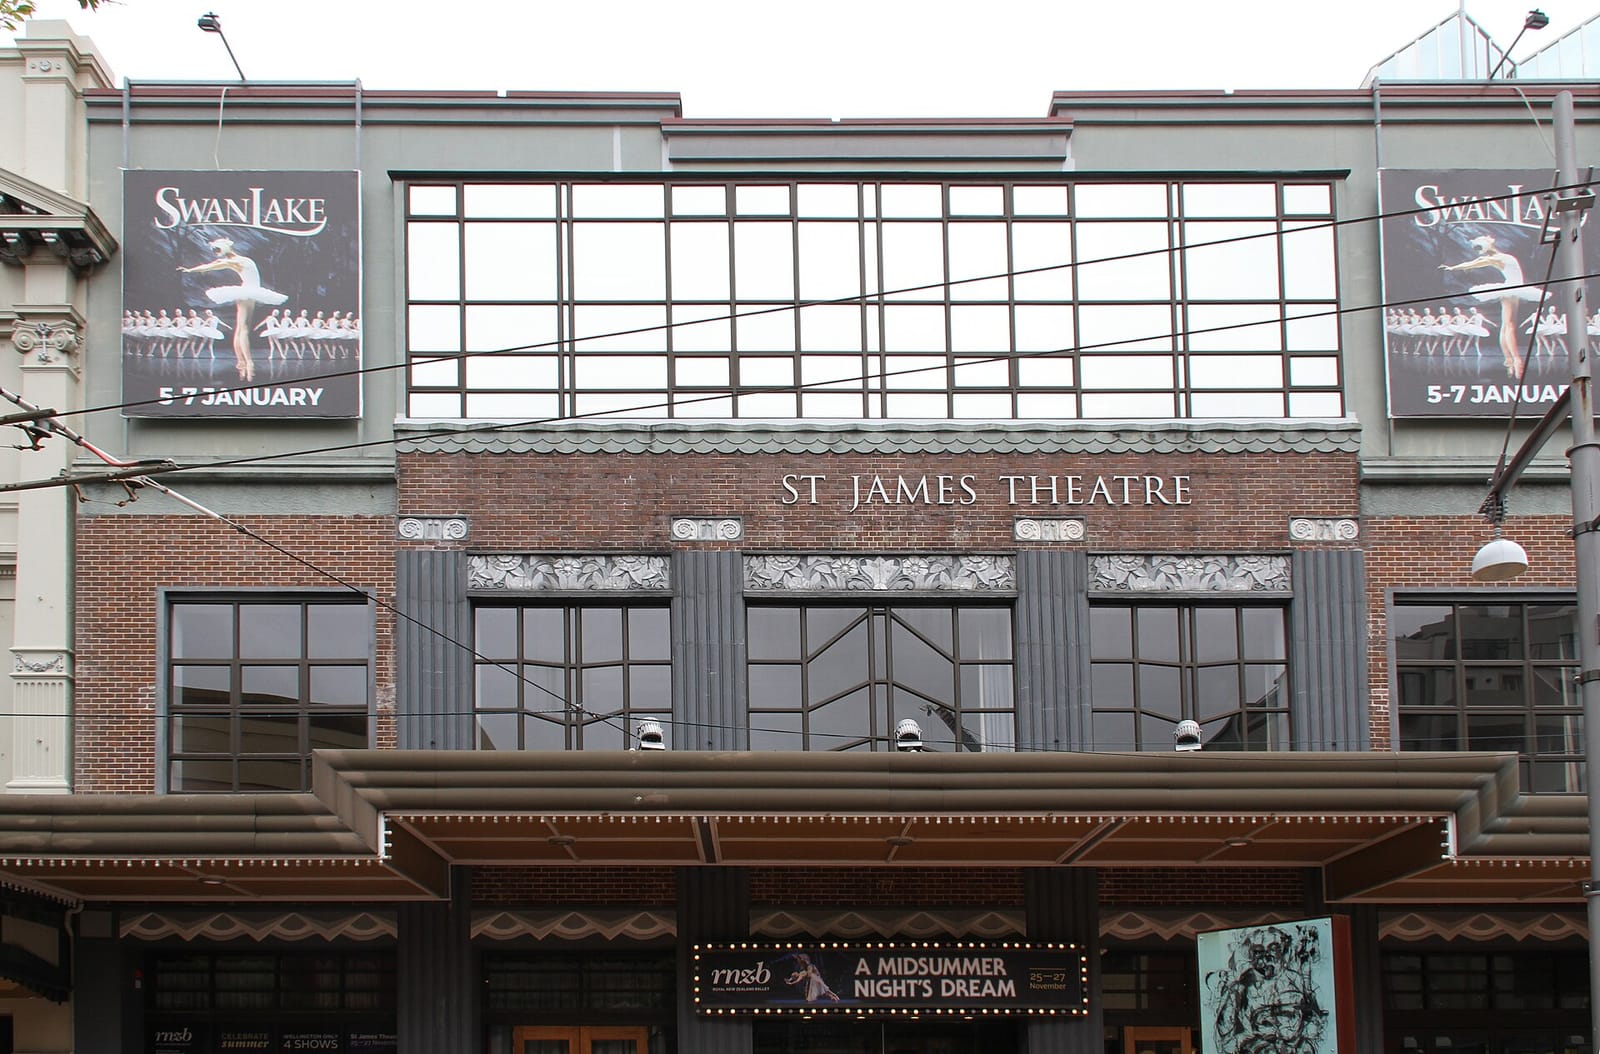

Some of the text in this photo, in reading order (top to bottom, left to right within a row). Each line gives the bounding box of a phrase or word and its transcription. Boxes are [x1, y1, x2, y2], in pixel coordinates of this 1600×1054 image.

[201, 387, 324, 405] JANUARY
[1427, 385, 1466, 403] 5-7
[781, 474, 1192, 513] ST JAMES THEATRE
[711, 961, 771, 985] rnzb
[855, 957, 1007, 976] A MIDSUMMER
[941, 979, 1017, 998] DREAM
[221, 1040, 270, 1048] summer
[283, 1039, 339, 1049] 4 SHOWS
